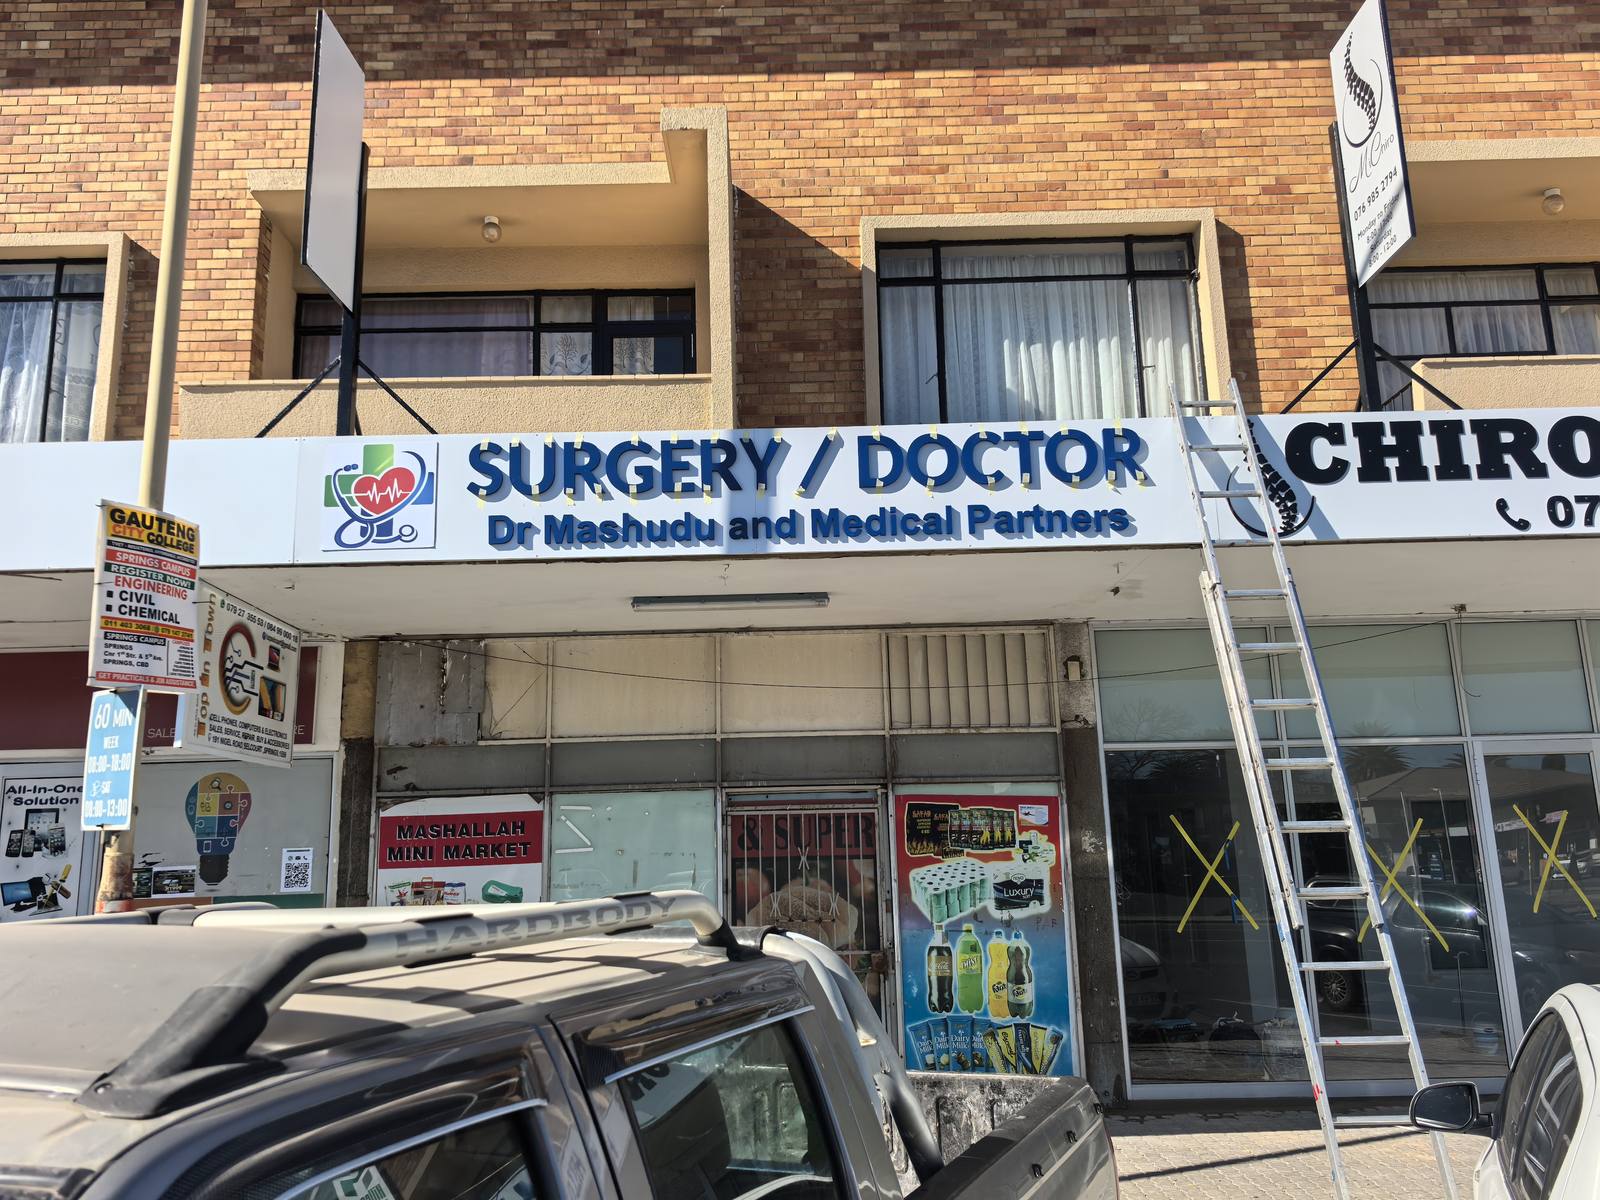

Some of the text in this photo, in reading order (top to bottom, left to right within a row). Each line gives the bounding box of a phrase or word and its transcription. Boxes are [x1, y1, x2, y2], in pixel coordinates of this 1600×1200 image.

[1354, 166, 1398, 221] 076 985 2794
[1358, 192, 1401, 241] Monday to Friday
[1370, 226, 1392, 252] Saturday
[1285, 415, 1600, 484] CHIRO
[466, 428, 1147, 496] SURGERY / DOCTOR
[1547, 494, 1600, 528] 07
[110, 508, 195, 542] GAUTENG
[112, 524, 144, 538] CITY
[488, 504, 1130, 546] Dr Mashudu and Medical Partners
[146, 532, 194, 554] COLLEGE
[116, 552, 160, 568] SPRINGS
[162, 561, 191, 576] CAMPUS
[110, 564, 191, 588] REGISTER NOW!
[114, 576, 188, 600] ENGINEERING
[119, 590, 156, 606] CIVIL
[118, 604, 180, 624] CHEMICAL
[238, 608, 246, 618] 27
[104, 642, 133, 650] SPRINGS
[106, 632, 165, 646] SPRINGS CAMPUS
[94, 703, 132, 729] 60 MIN
[238, 720, 261, 732] COMPUTERS
[264, 728, 288, 739] ELECTRONICS
[104, 736, 119, 749] WEEK
[12, 796, 79, 806] Solution
[396, 820, 526, 841] MASHALLAH
[738, 814, 873, 851] & SUPER
[386, 842, 532, 862] MINI MARKET
[1004, 888, 1034, 897] Luxury
[396, 896, 676, 958] HARDBODY
[951, 1035, 970, 1043] Dairy
